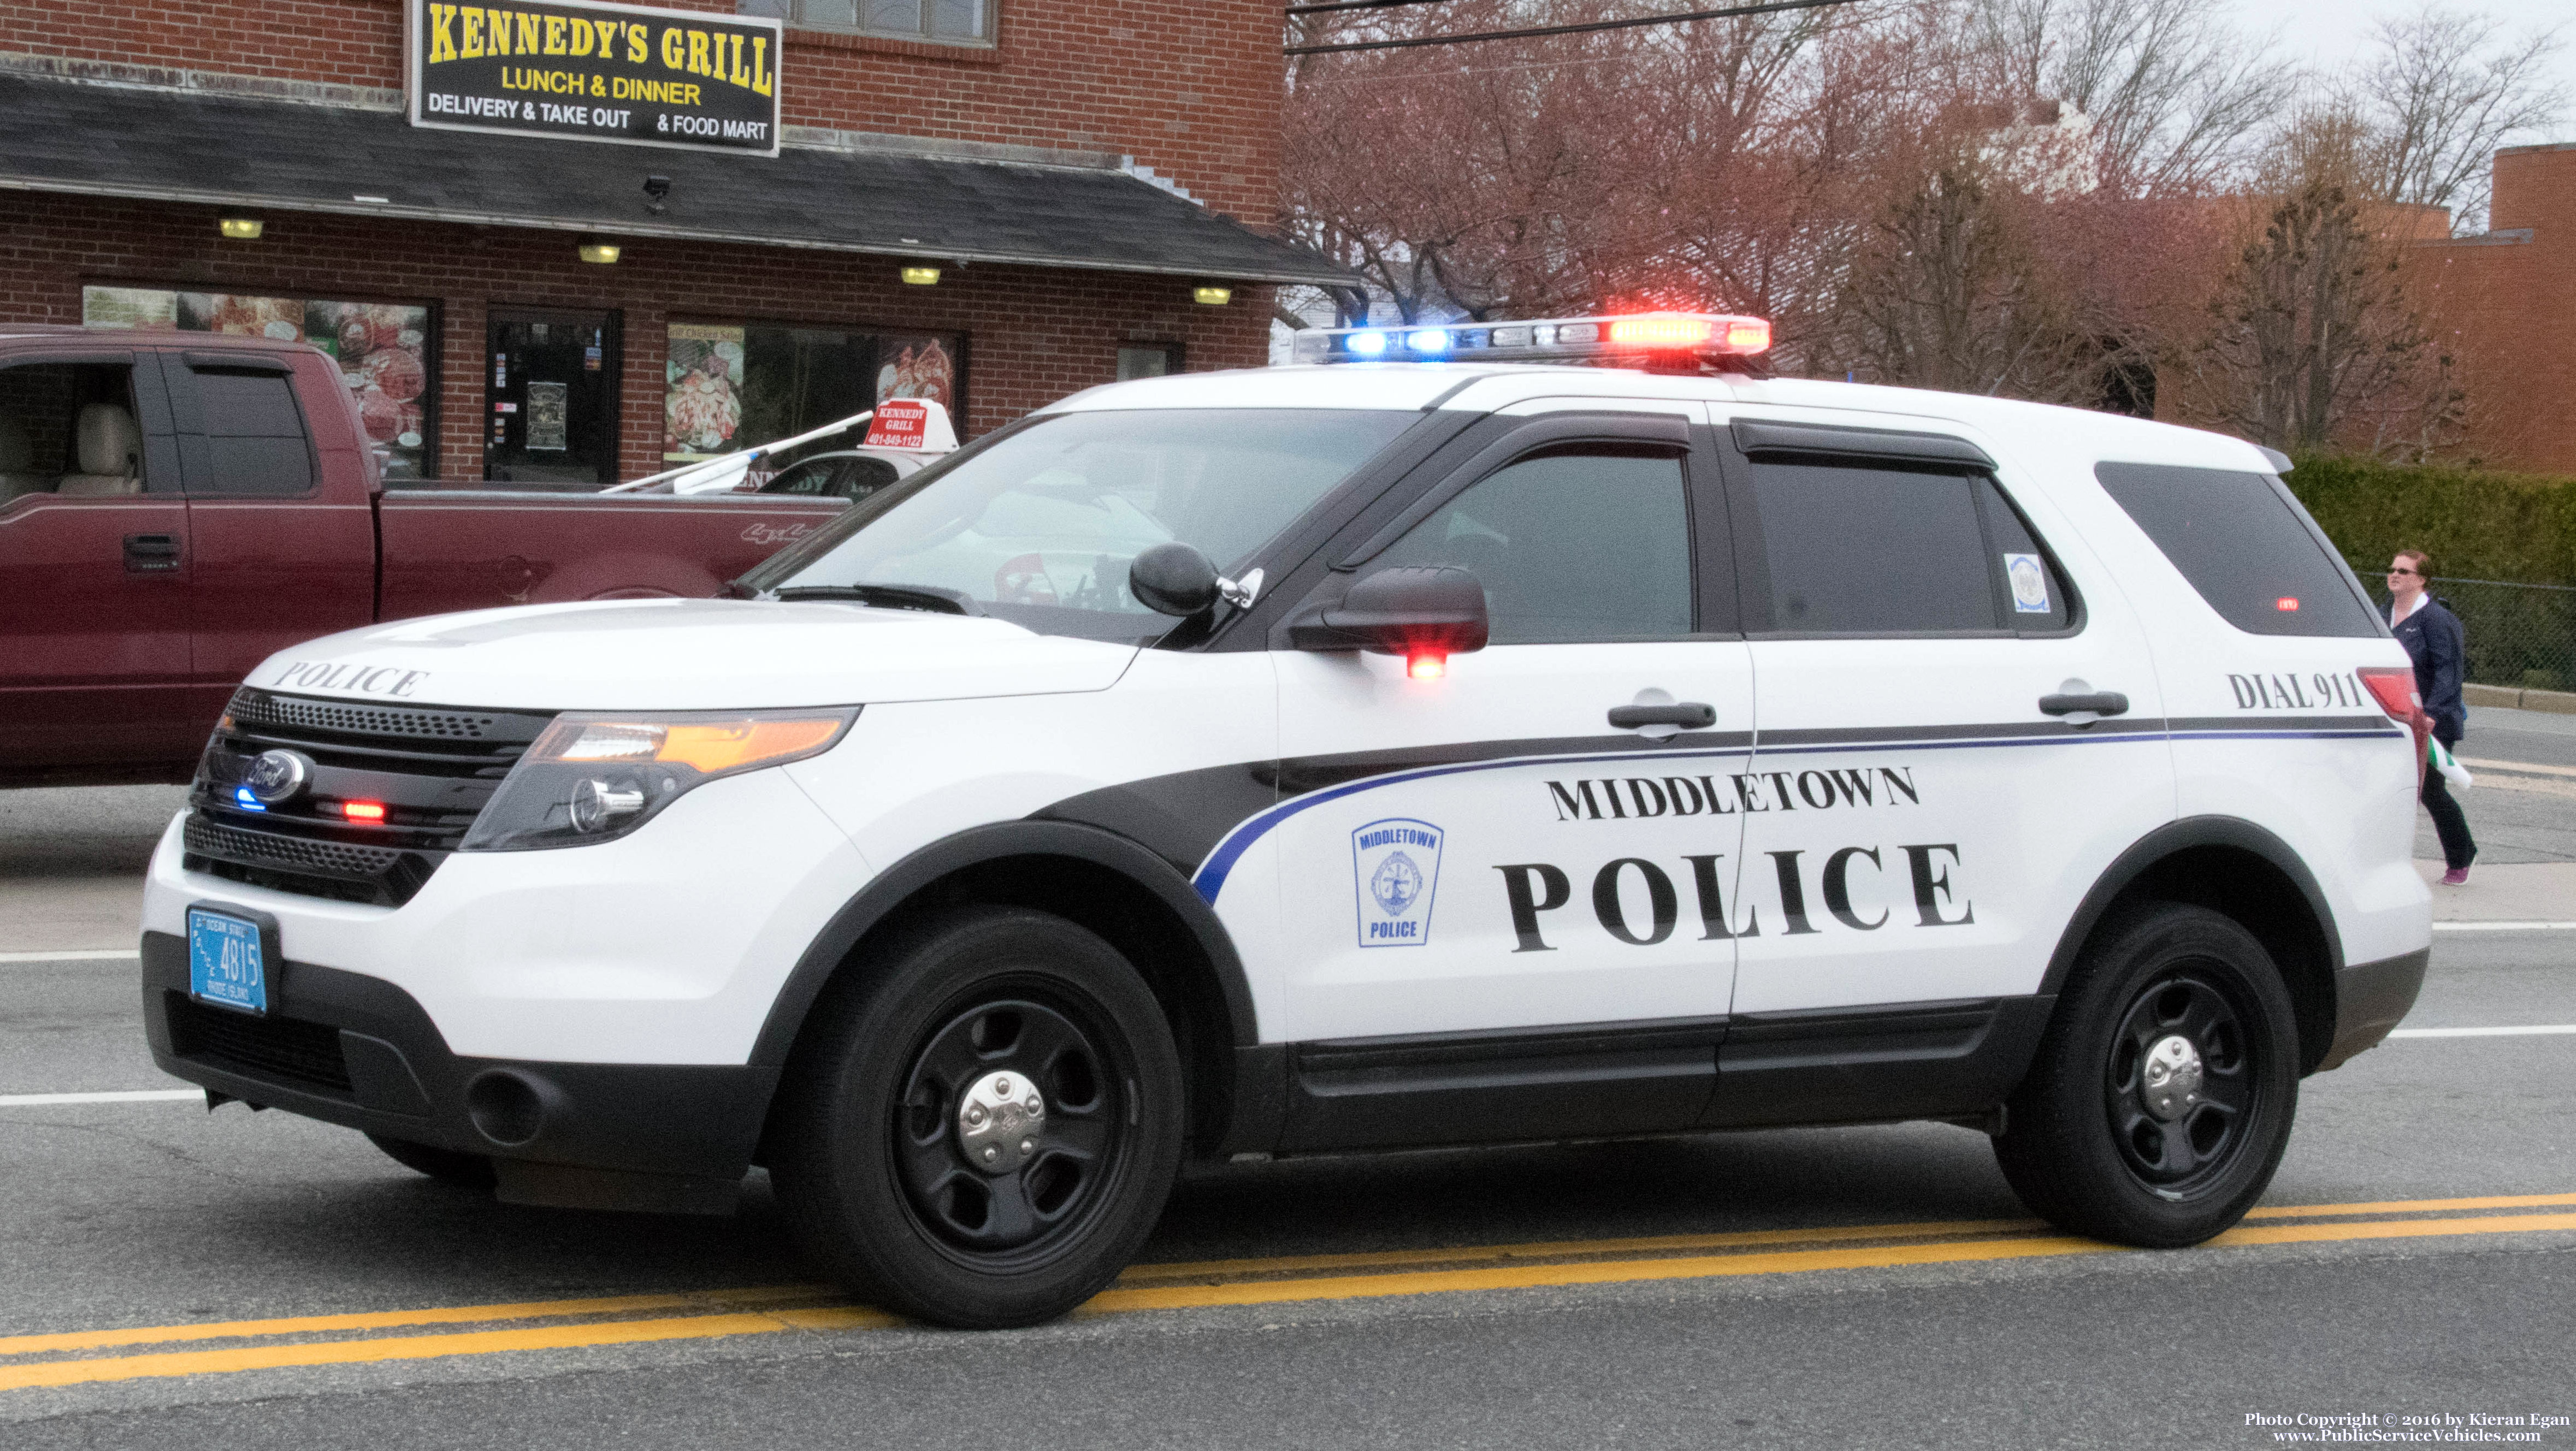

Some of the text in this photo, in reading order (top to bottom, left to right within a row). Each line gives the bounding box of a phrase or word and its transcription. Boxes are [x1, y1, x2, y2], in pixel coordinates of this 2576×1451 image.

[429, 3, 772, 97] KENNEDY'S GRILL
[502, 66, 701, 105] LUNCH & DINNER
[429, 93, 768, 140] DELIVERY & TAKE OUT & FOOD MART
[879, 407, 926, 419] KENNEDY
[885, 419, 914, 431] GRILL
[273, 662, 431, 697] POLICE
[2225, 672, 2364, 709] DIAL 911
[1544, 767, 1920, 821] MIDDLETOWN
[1360, 828, 1437, 850] MIDDLETOWN
[1492, 843, 1975, 953] POLICE
[1370, 921, 1417, 938] POLICE
[221, 936, 258, 986] 4815
